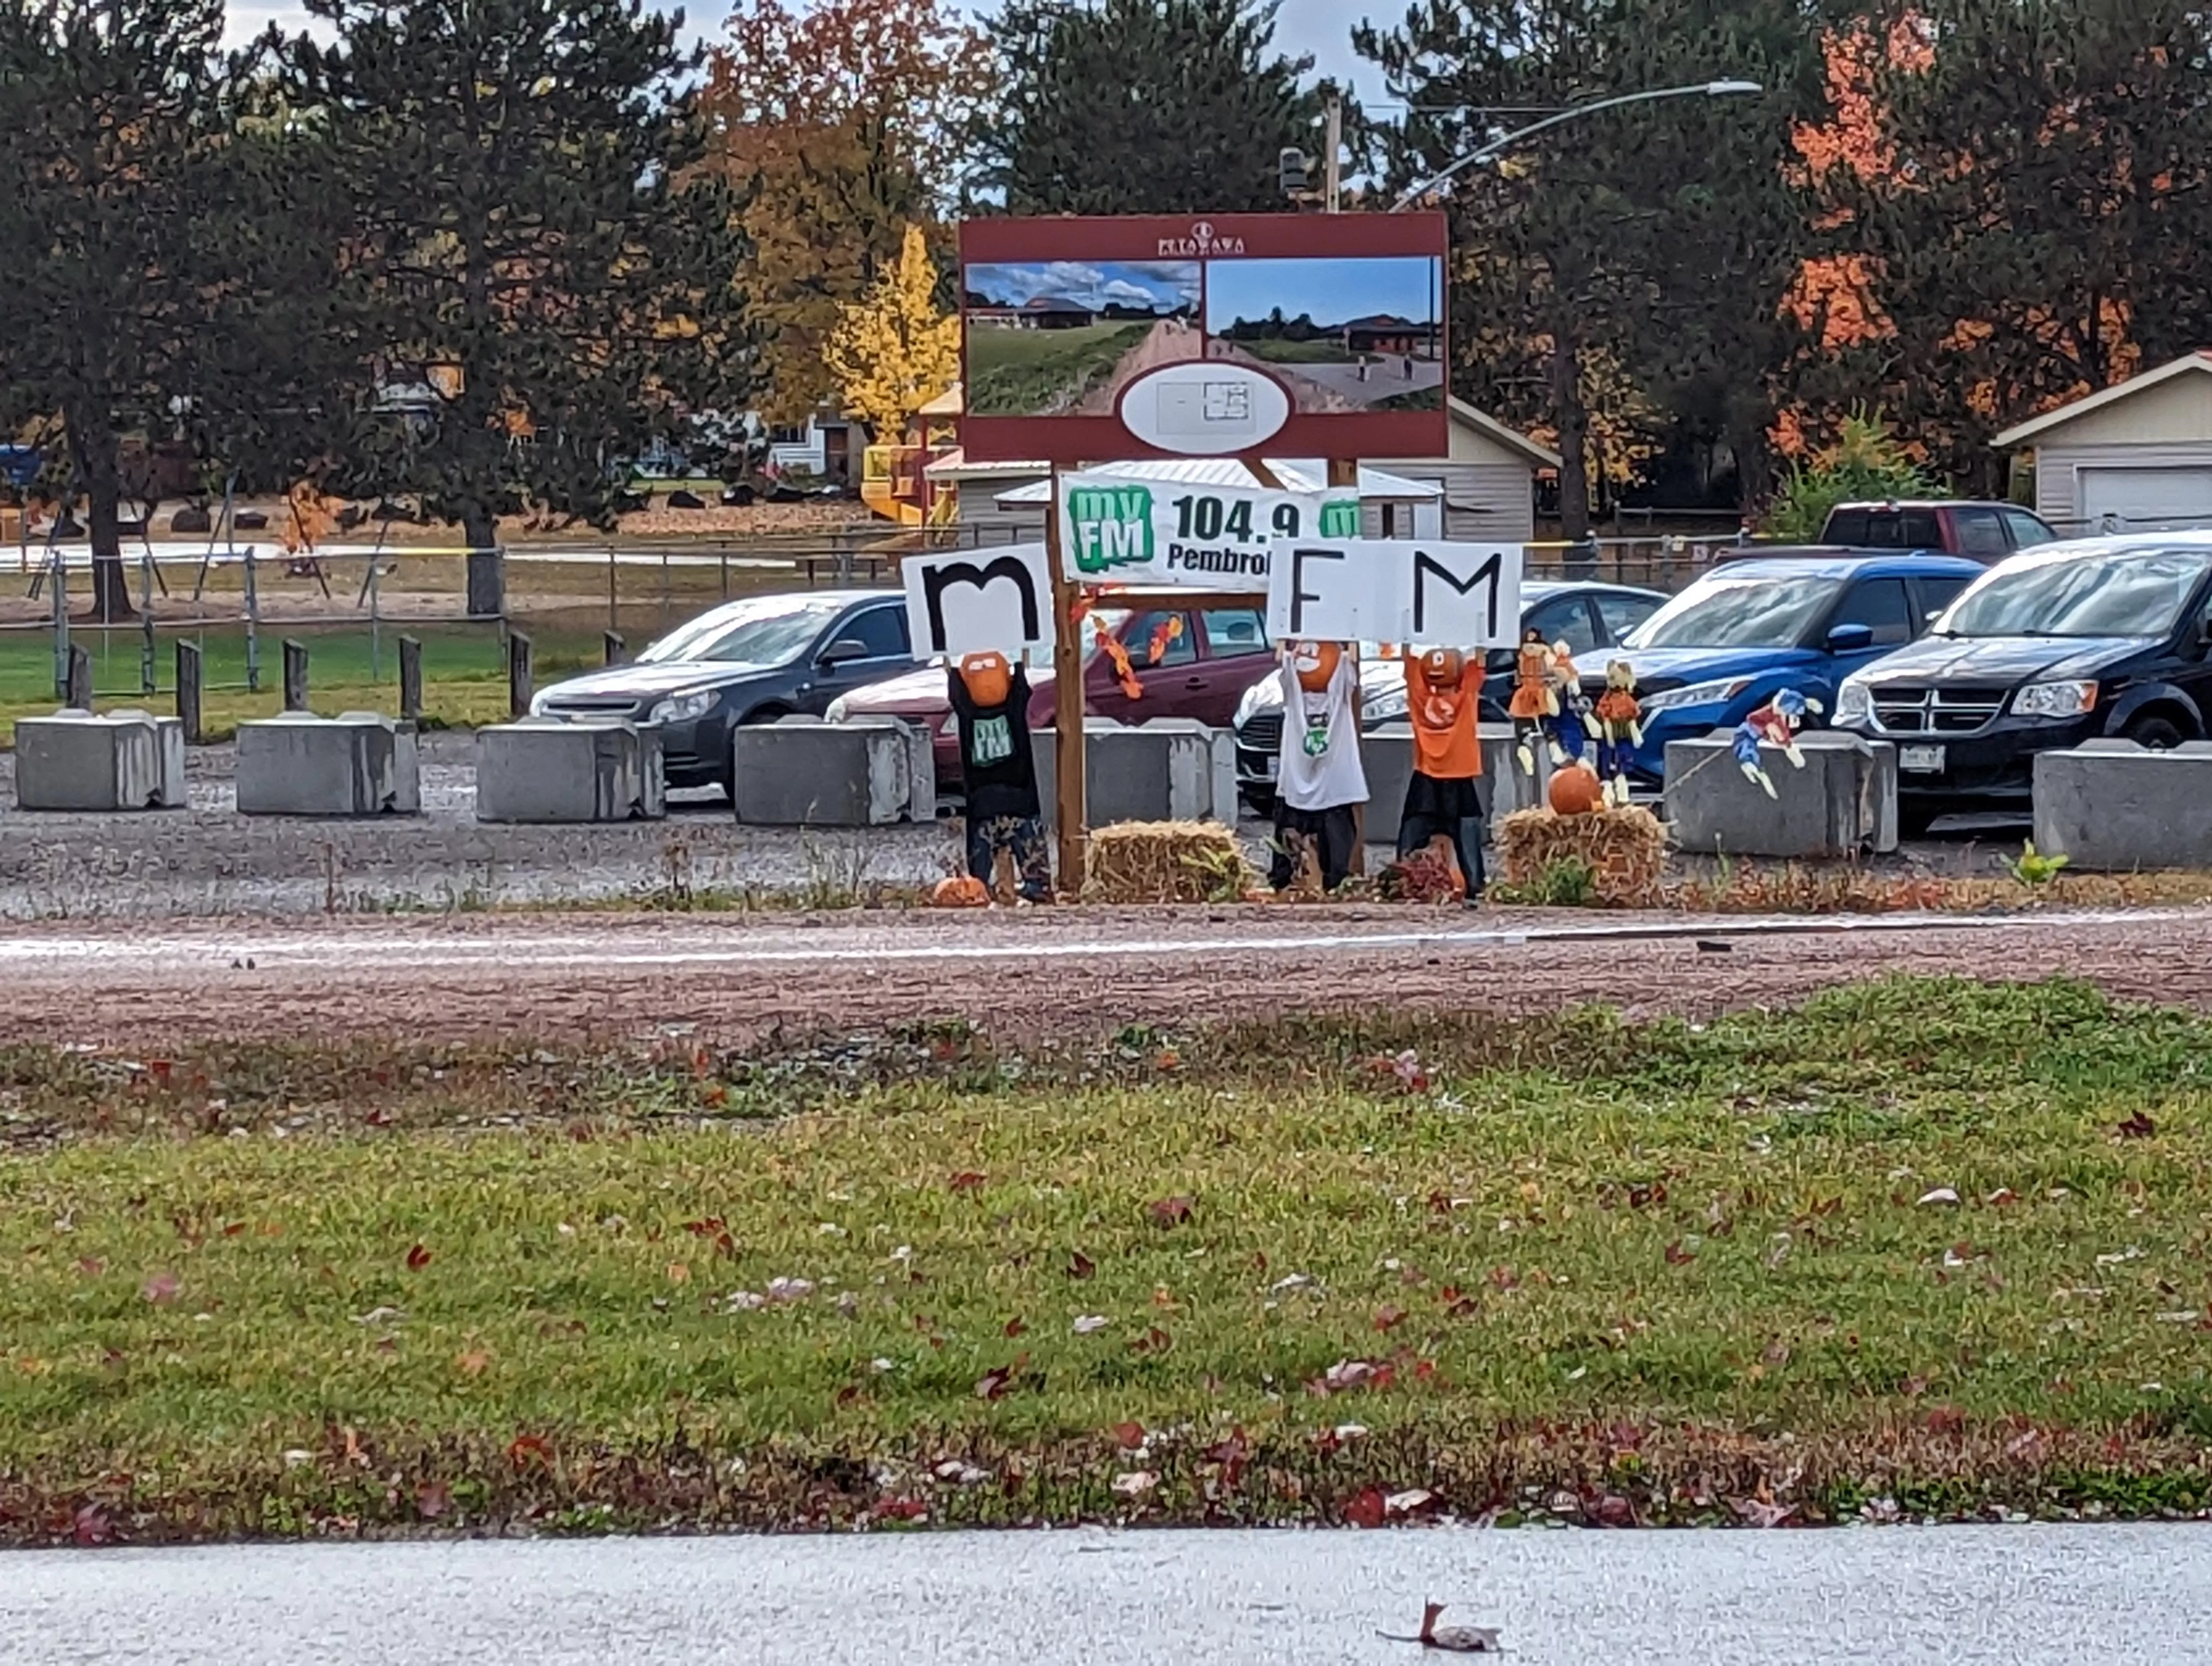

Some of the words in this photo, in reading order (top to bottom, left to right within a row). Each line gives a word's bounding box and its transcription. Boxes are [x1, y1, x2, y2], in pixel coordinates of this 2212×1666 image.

[1077, 492, 1144, 524] my
[1172, 495, 1300, 544] 104.9
[1079, 518, 1144, 560] FM
